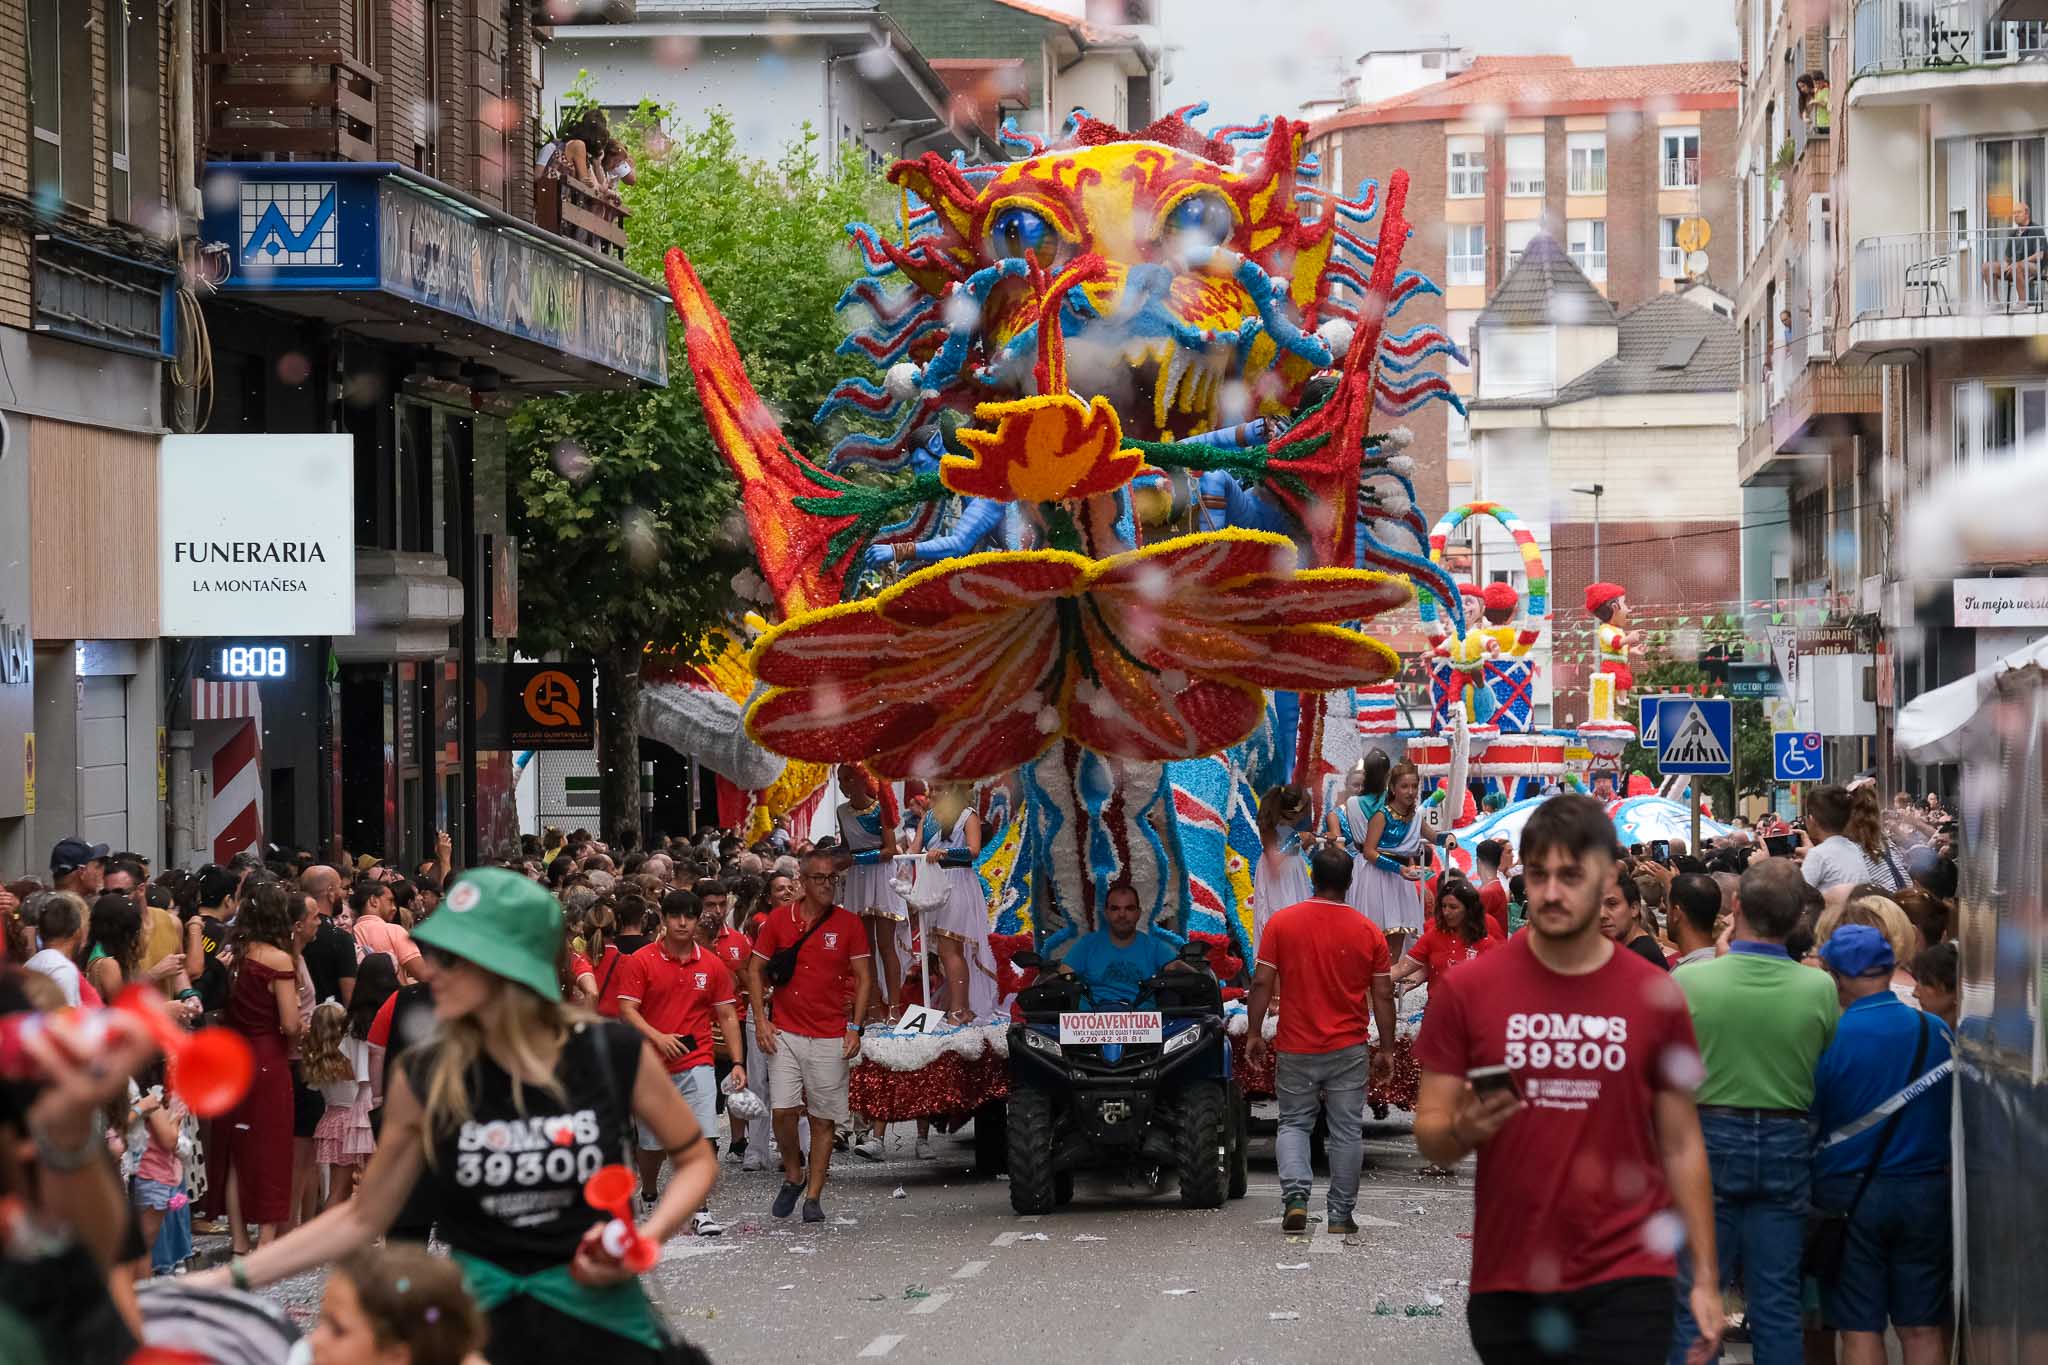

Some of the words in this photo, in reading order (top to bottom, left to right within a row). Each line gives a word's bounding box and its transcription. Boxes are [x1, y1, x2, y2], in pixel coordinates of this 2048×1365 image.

[175, 542, 326, 563] FUNERARIA
[193, 580, 210, 592] LA
[214, 577, 307, 592] MONTAÑESA
[1965, 597, 1980, 610] Tu
[1982, 597, 2015, 614] mejor
[1797, 629, 1852, 641] RESTAURANTE
[1430, 811, 1439, 825] B
[903, 1012, 927, 1033] A
[1062, 1014, 1159, 1030] VOTOAVENTURA
[1504, 1041, 1626, 1071] 39300
[456, 1144, 603, 1187] 39300
